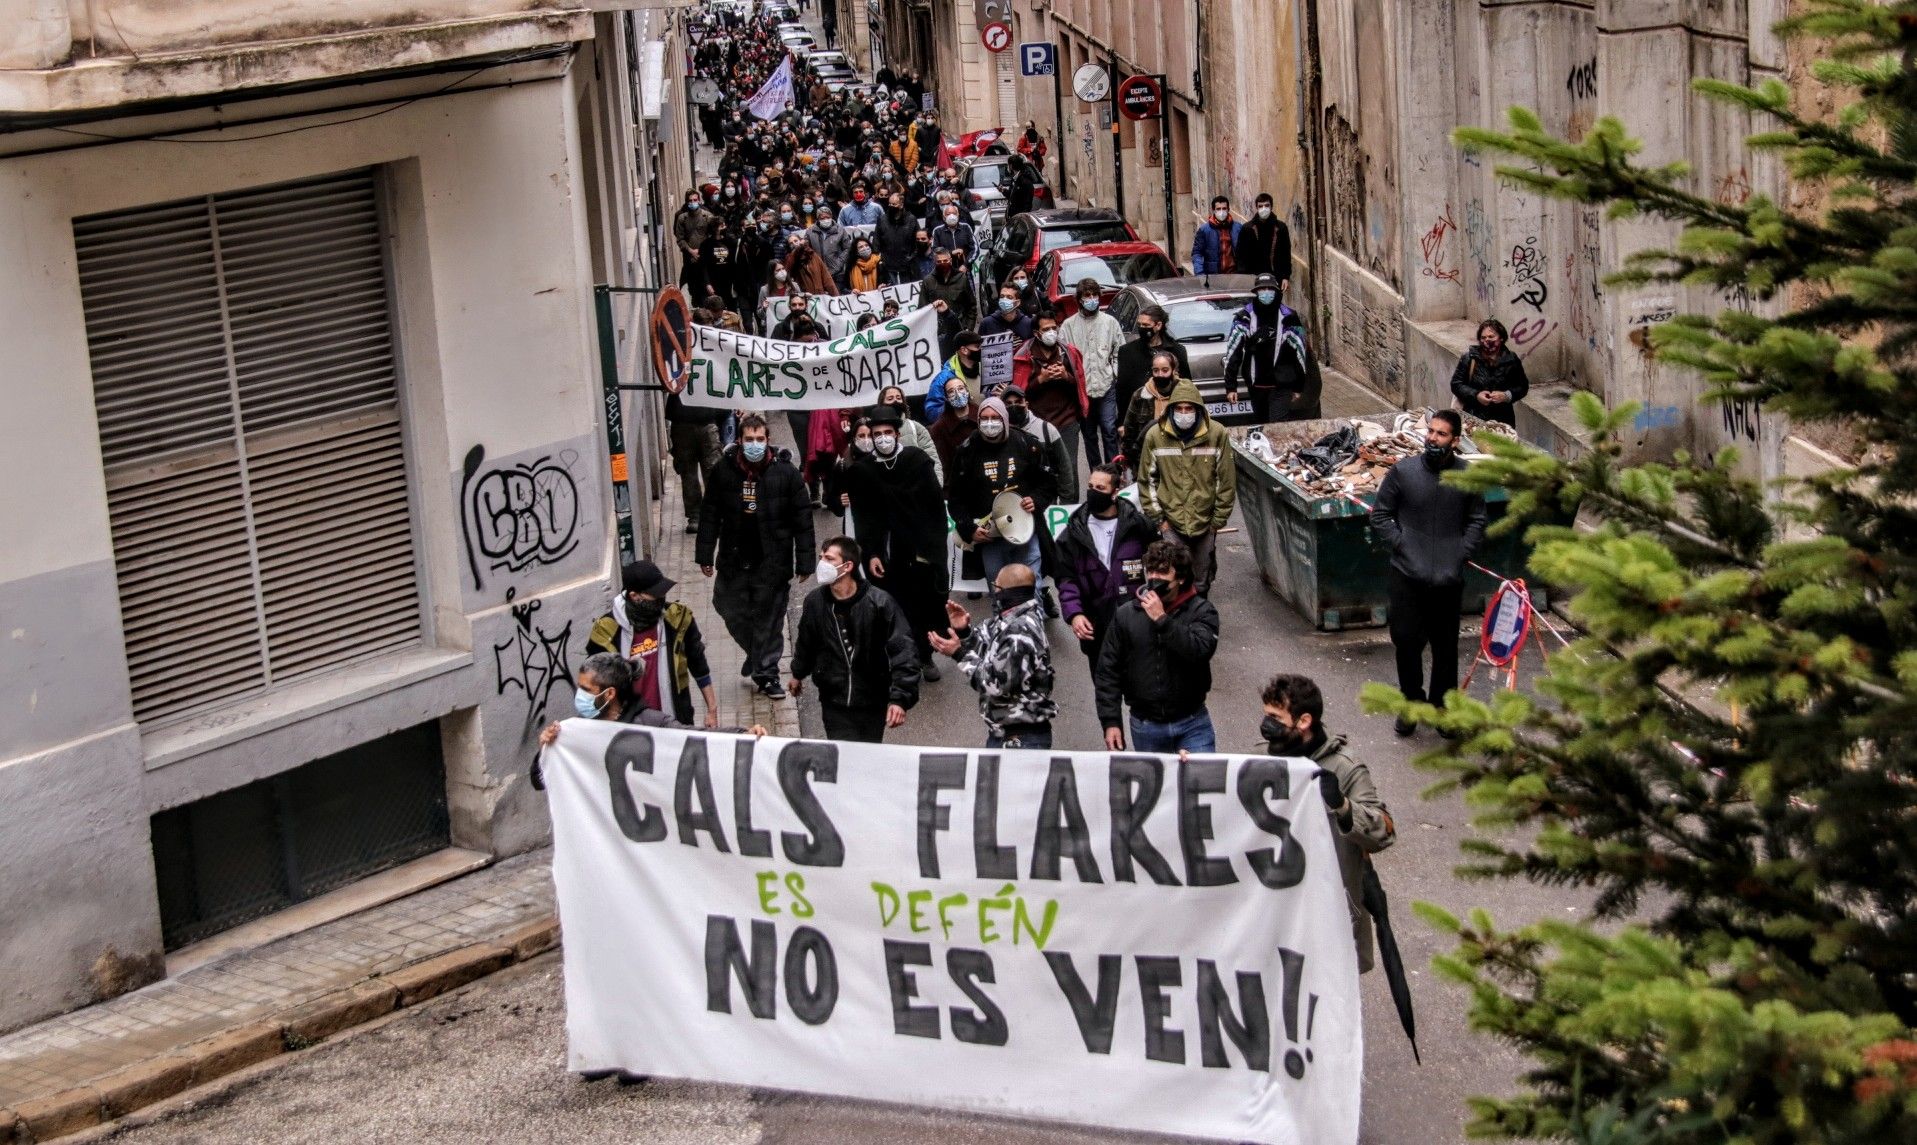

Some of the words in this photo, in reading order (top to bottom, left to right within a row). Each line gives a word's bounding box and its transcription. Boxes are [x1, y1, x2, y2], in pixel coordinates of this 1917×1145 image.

[881, 281, 923, 304] FLA
[828, 319, 910, 354] CALS
[687, 357, 808, 398] FLARES
[812, 365, 829, 376] DE
[814, 380, 834, 390] LA
[605, 728, 846, 868] CALS
[917, 752, 1306, 890] FLARES
[756, 870, 815, 918] ES
[870, 882, 1059, 950] DEFÉN
[705, 914, 839, 1026] NO
[883, 938, 1009, 1046] ES
